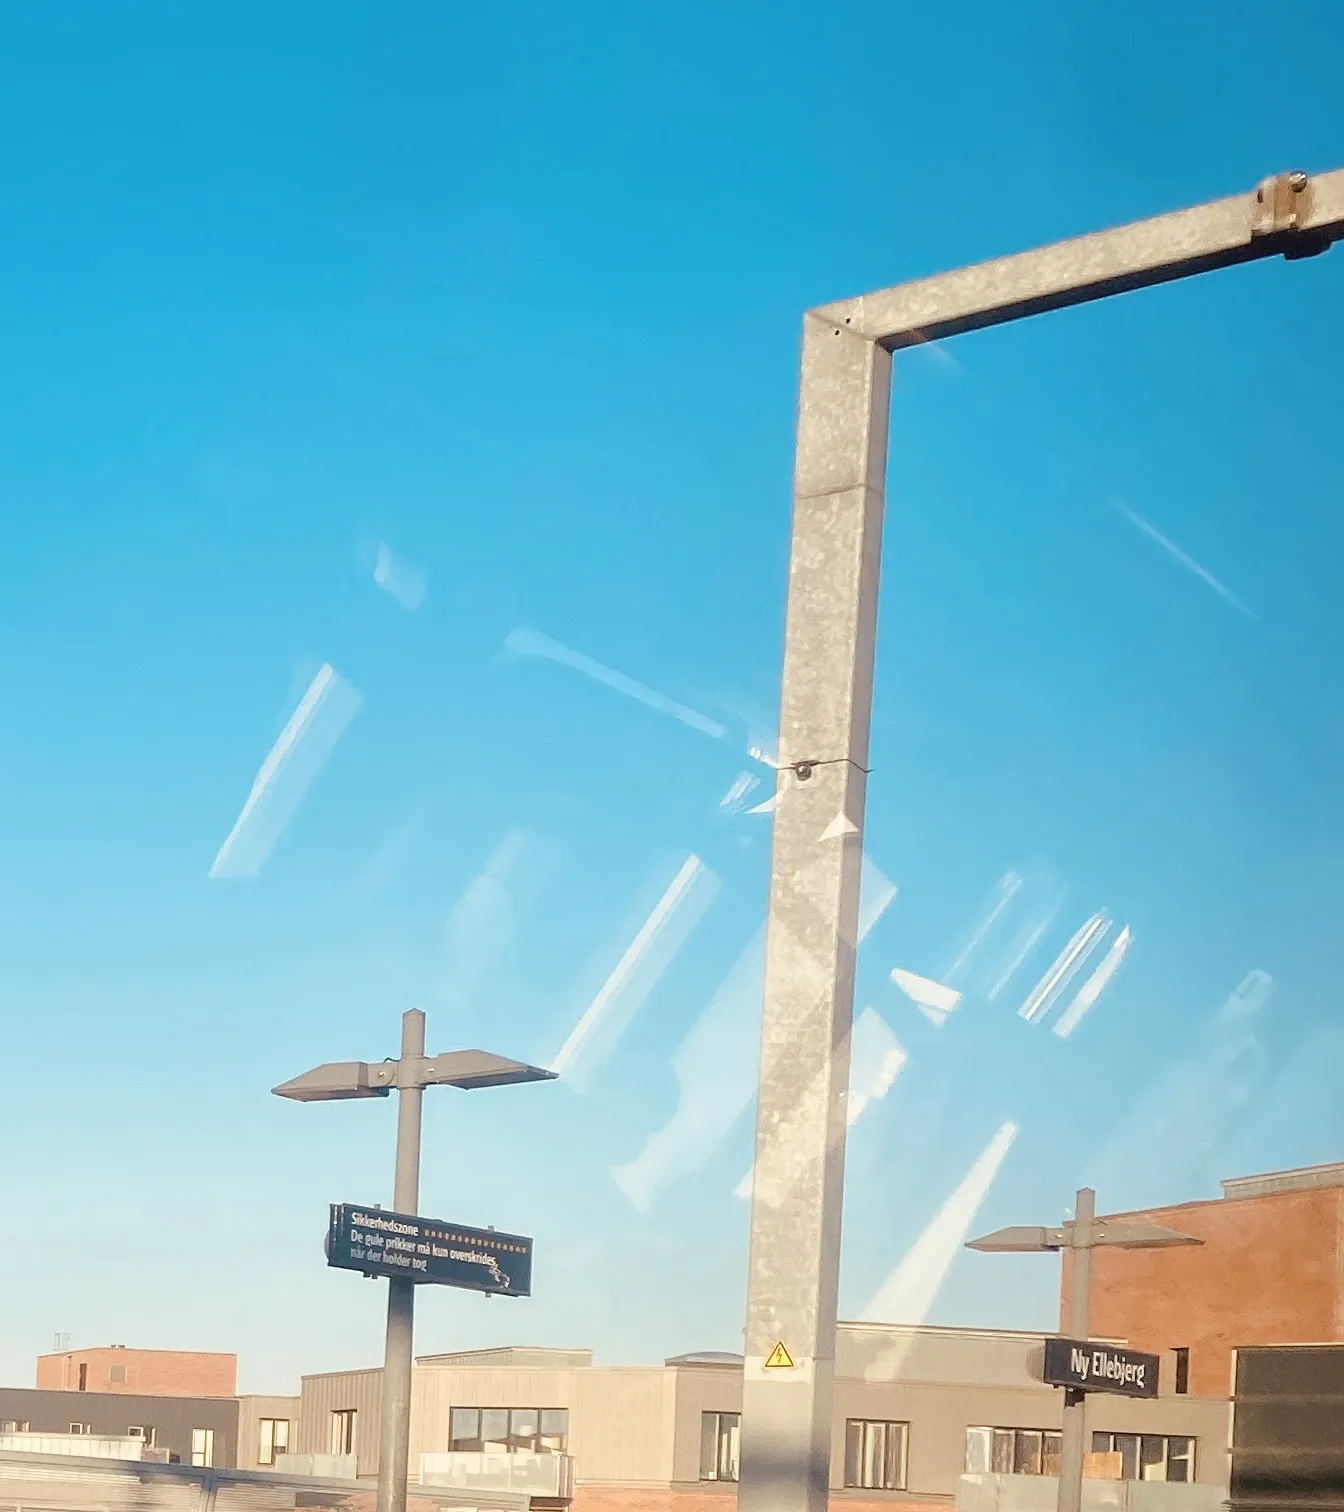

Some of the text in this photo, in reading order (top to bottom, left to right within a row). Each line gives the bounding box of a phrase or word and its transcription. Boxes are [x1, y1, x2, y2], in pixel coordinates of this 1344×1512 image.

[351, 1212, 418, 1236] Sikkerhedszone
[351, 1229, 364, 1243] De
[365, 1233, 384, 1247] gule
[386, 1237, 416, 1252] prikker
[417, 1241, 431, 1255] må
[432, 1243, 449, 1258] kun
[367, 1249, 382, 1262] der
[383, 1250, 411, 1267] holder
[412, 1258, 427, 1272] tog
[1071, 1348, 1145, 1388] Ny Ellebjerg
